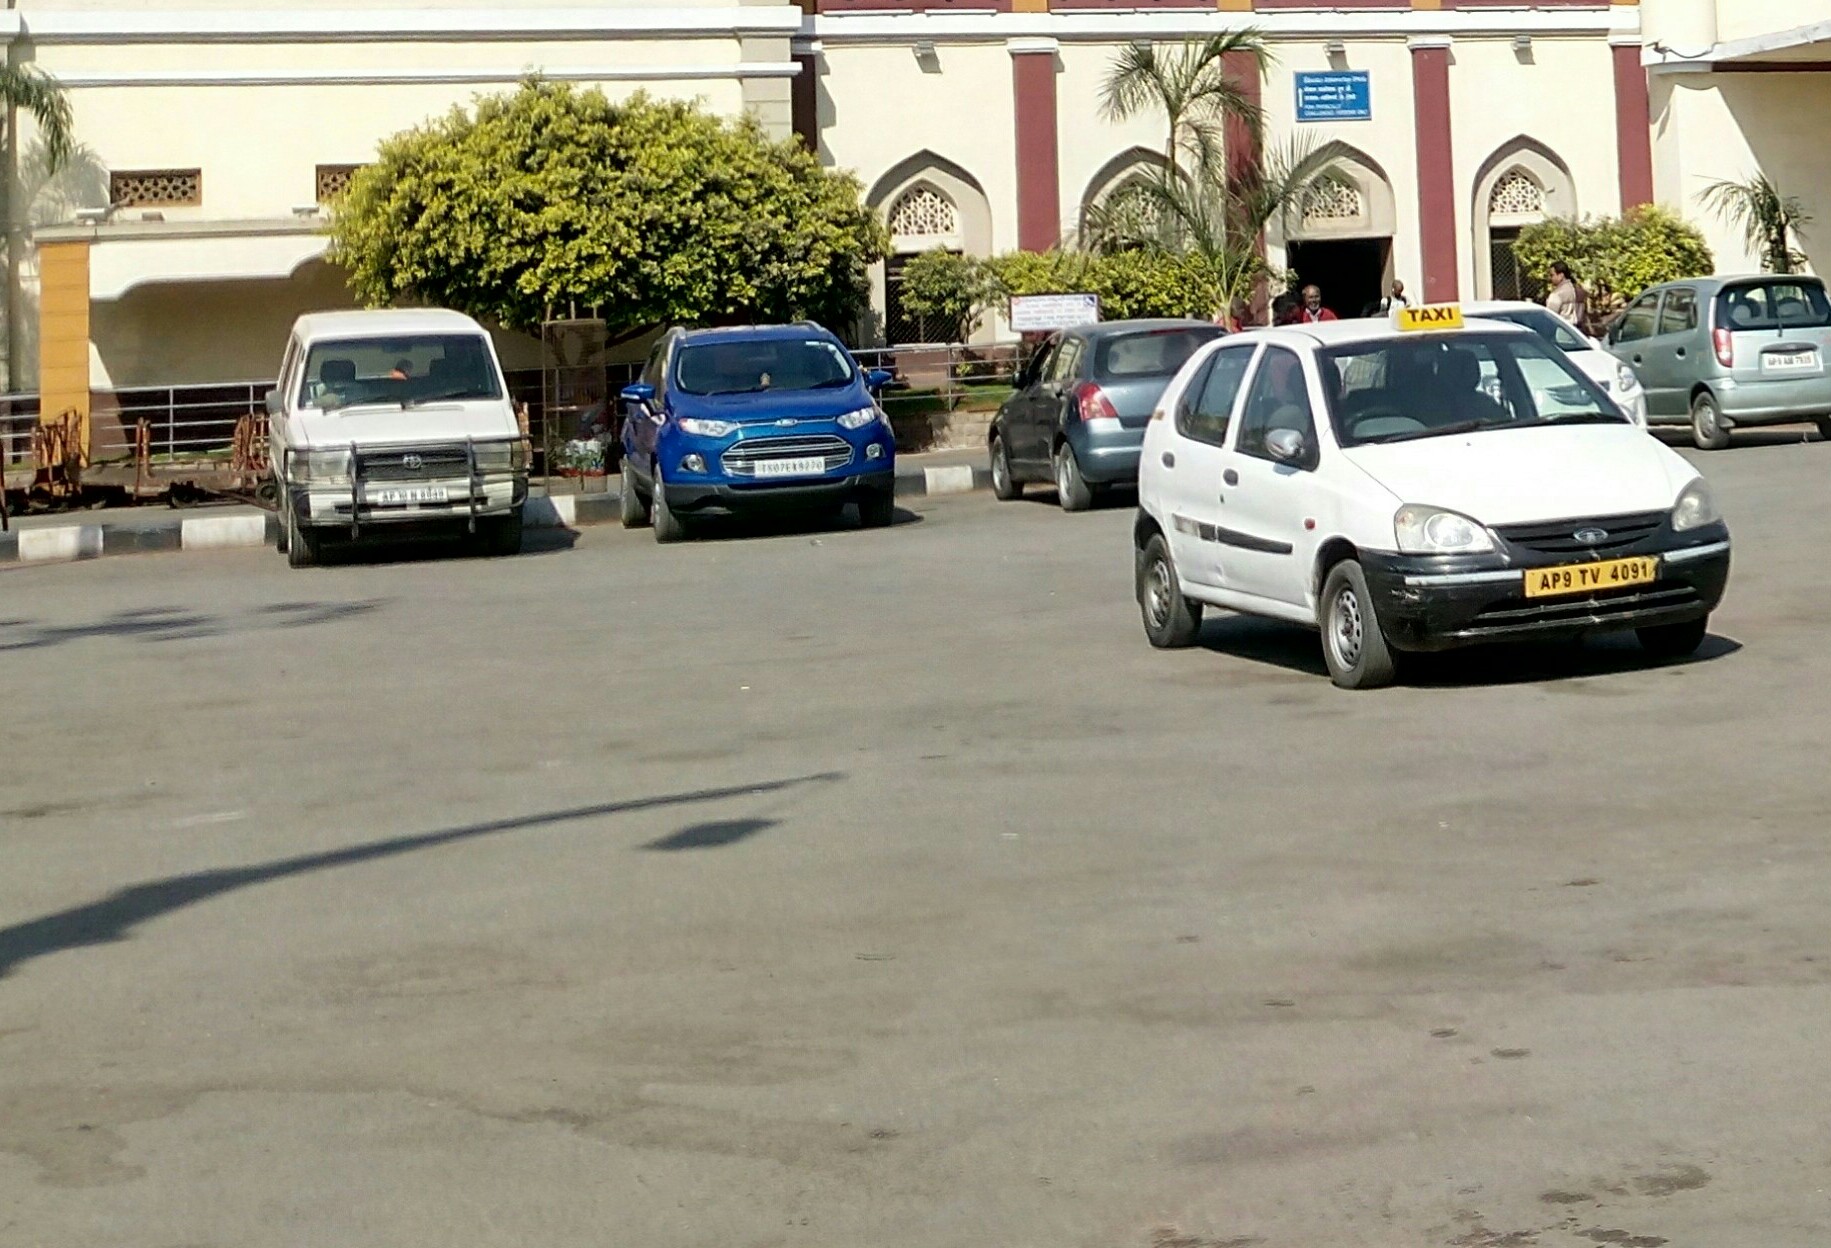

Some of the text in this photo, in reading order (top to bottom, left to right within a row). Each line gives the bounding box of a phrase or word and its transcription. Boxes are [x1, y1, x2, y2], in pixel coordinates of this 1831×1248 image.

[1406, 307, 1453, 322] TAXI
[1540, 562, 1647, 590] AP9 TV 4091
